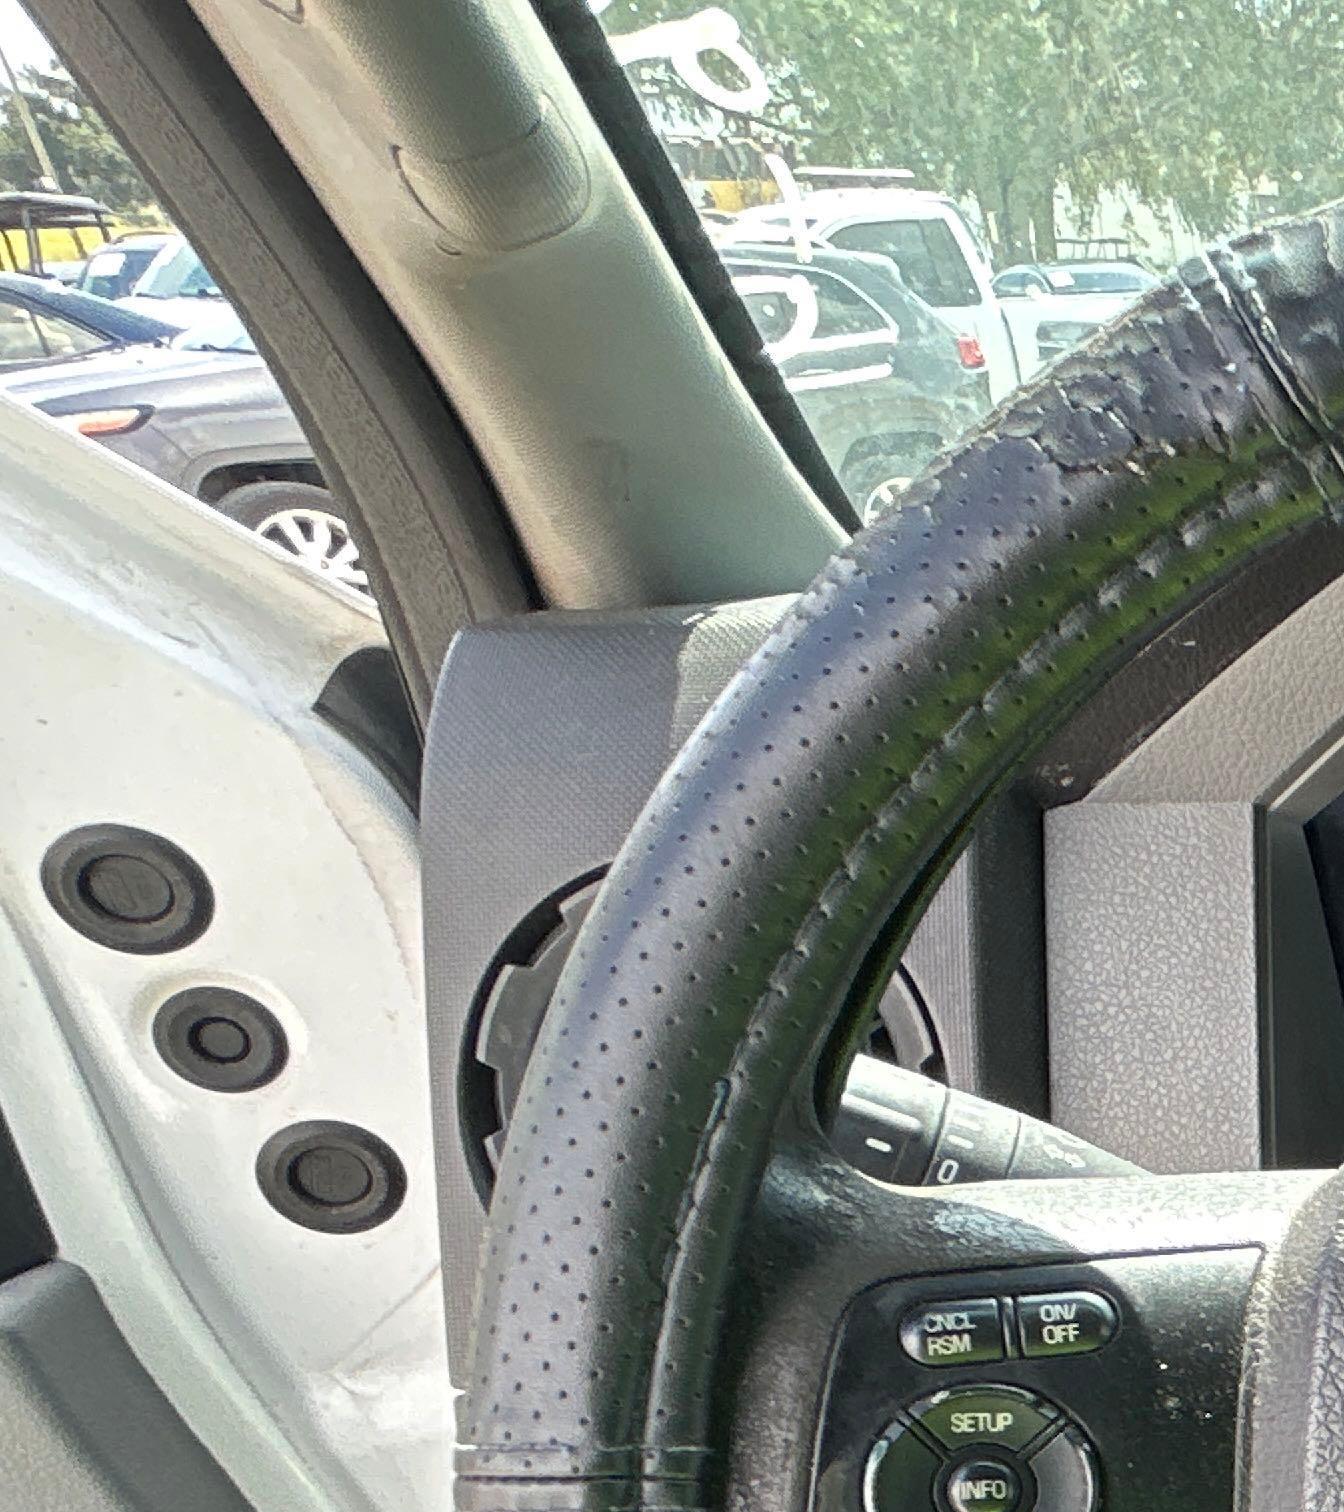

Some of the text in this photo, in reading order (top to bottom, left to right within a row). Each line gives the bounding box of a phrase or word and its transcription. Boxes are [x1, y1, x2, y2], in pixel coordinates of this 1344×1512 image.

[936, 1158, 960, 1184] 0
[924, 1312, 977, 1332] CNCL
[1040, 1303, 1077, 1322] ON/
[1042, 1323, 1080, 1344] OFF
[926, 1333, 972, 1356] RSM
[950, 1412, 1013, 1434] SETUP
[958, 1479, 1007, 1500] INFO
